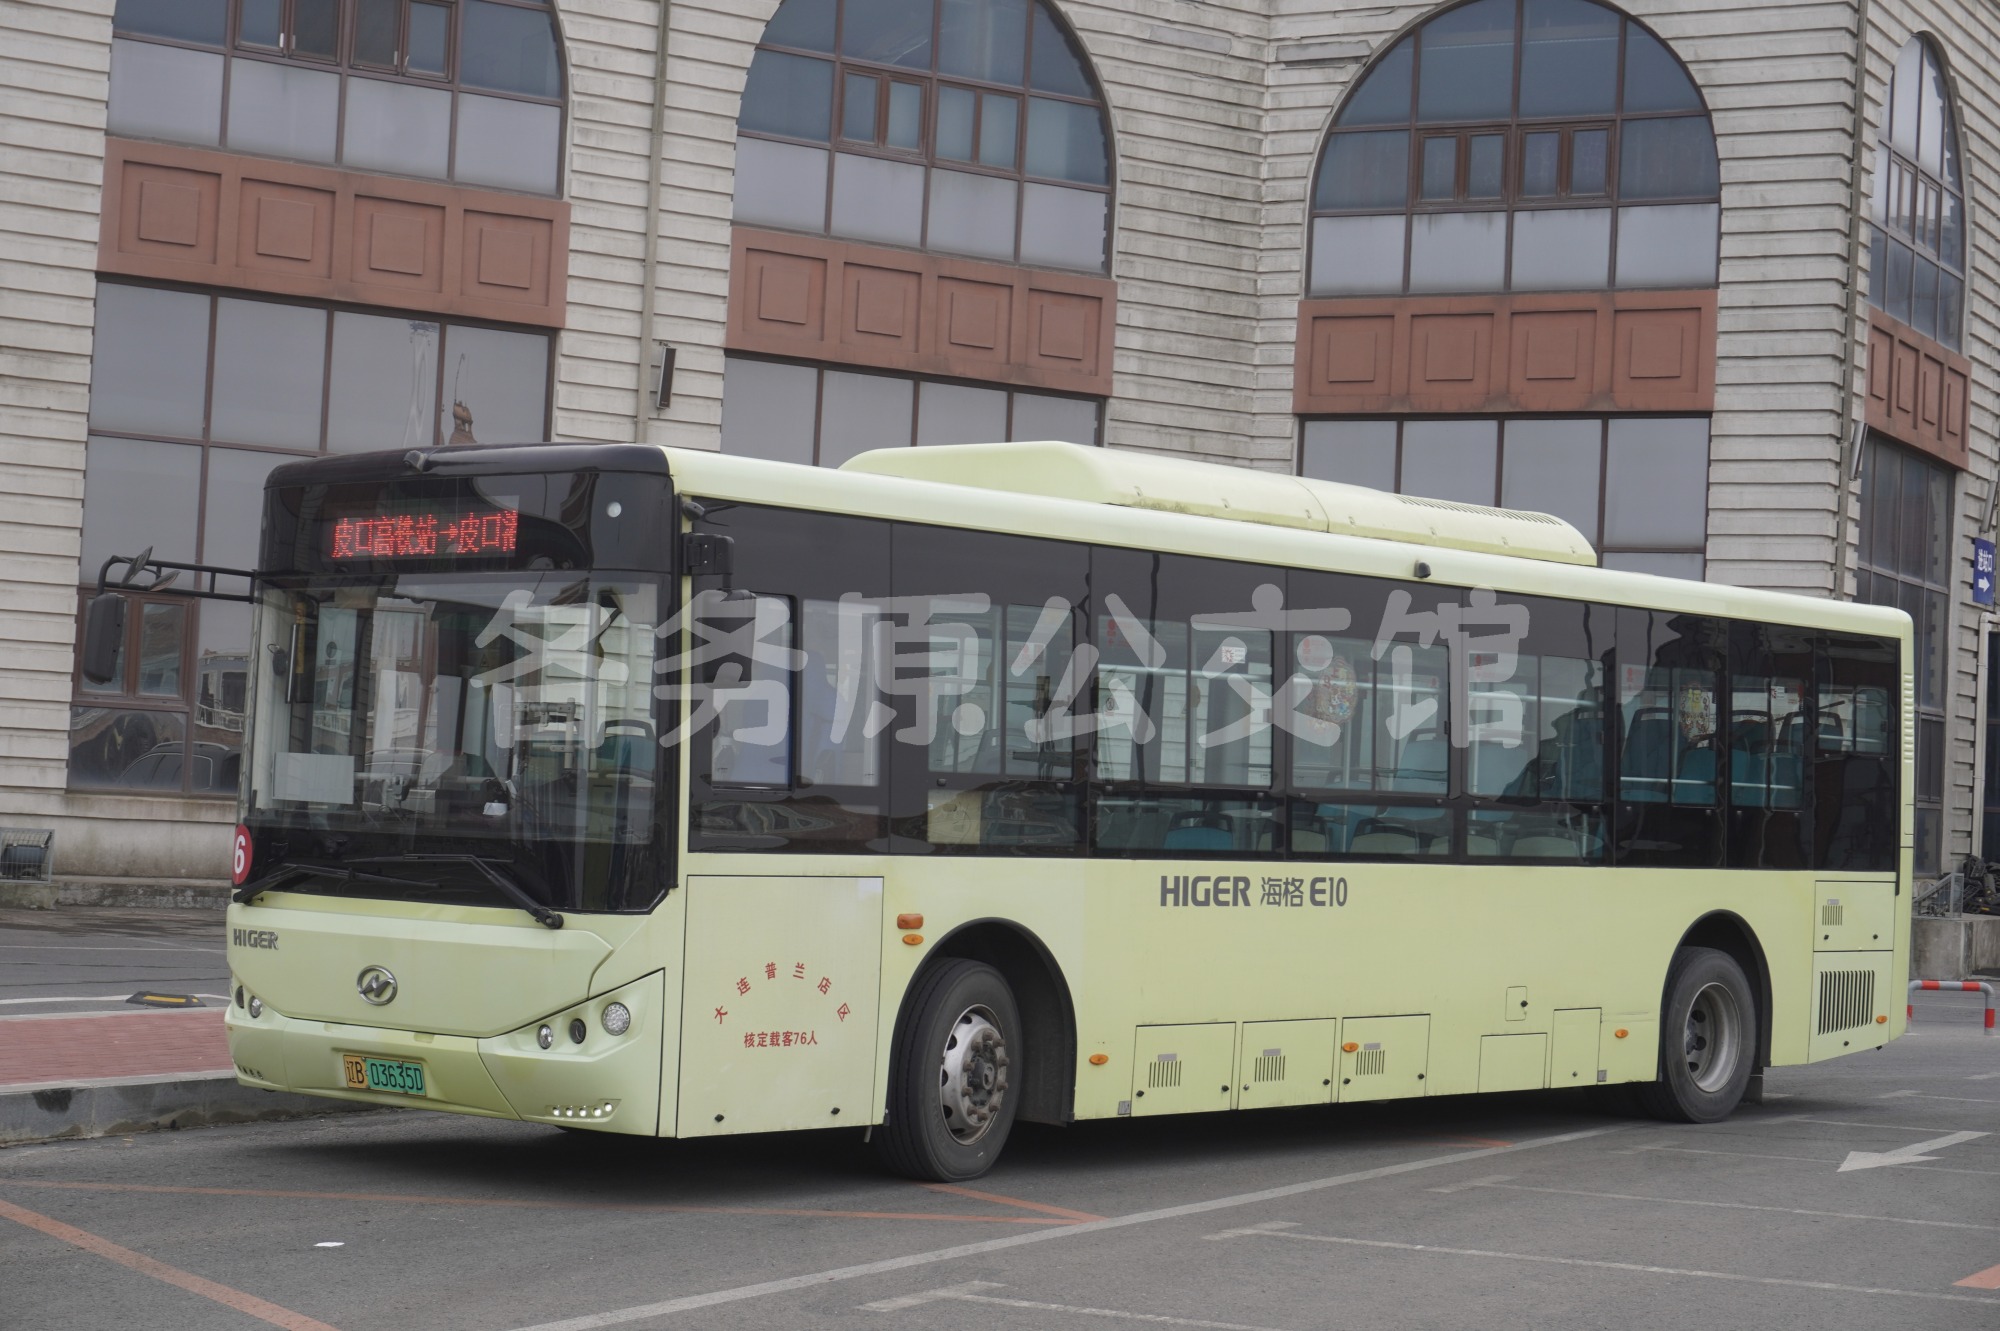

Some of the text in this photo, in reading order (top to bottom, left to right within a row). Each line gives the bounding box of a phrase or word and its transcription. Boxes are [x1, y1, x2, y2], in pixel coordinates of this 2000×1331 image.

[233, 834, 246, 875] 6
[1160, 875, 1348, 907] HIGER 海格 E10
[233, 928, 279, 950] HIGER
[743, 1030, 818, 1048] 核定载客76人
